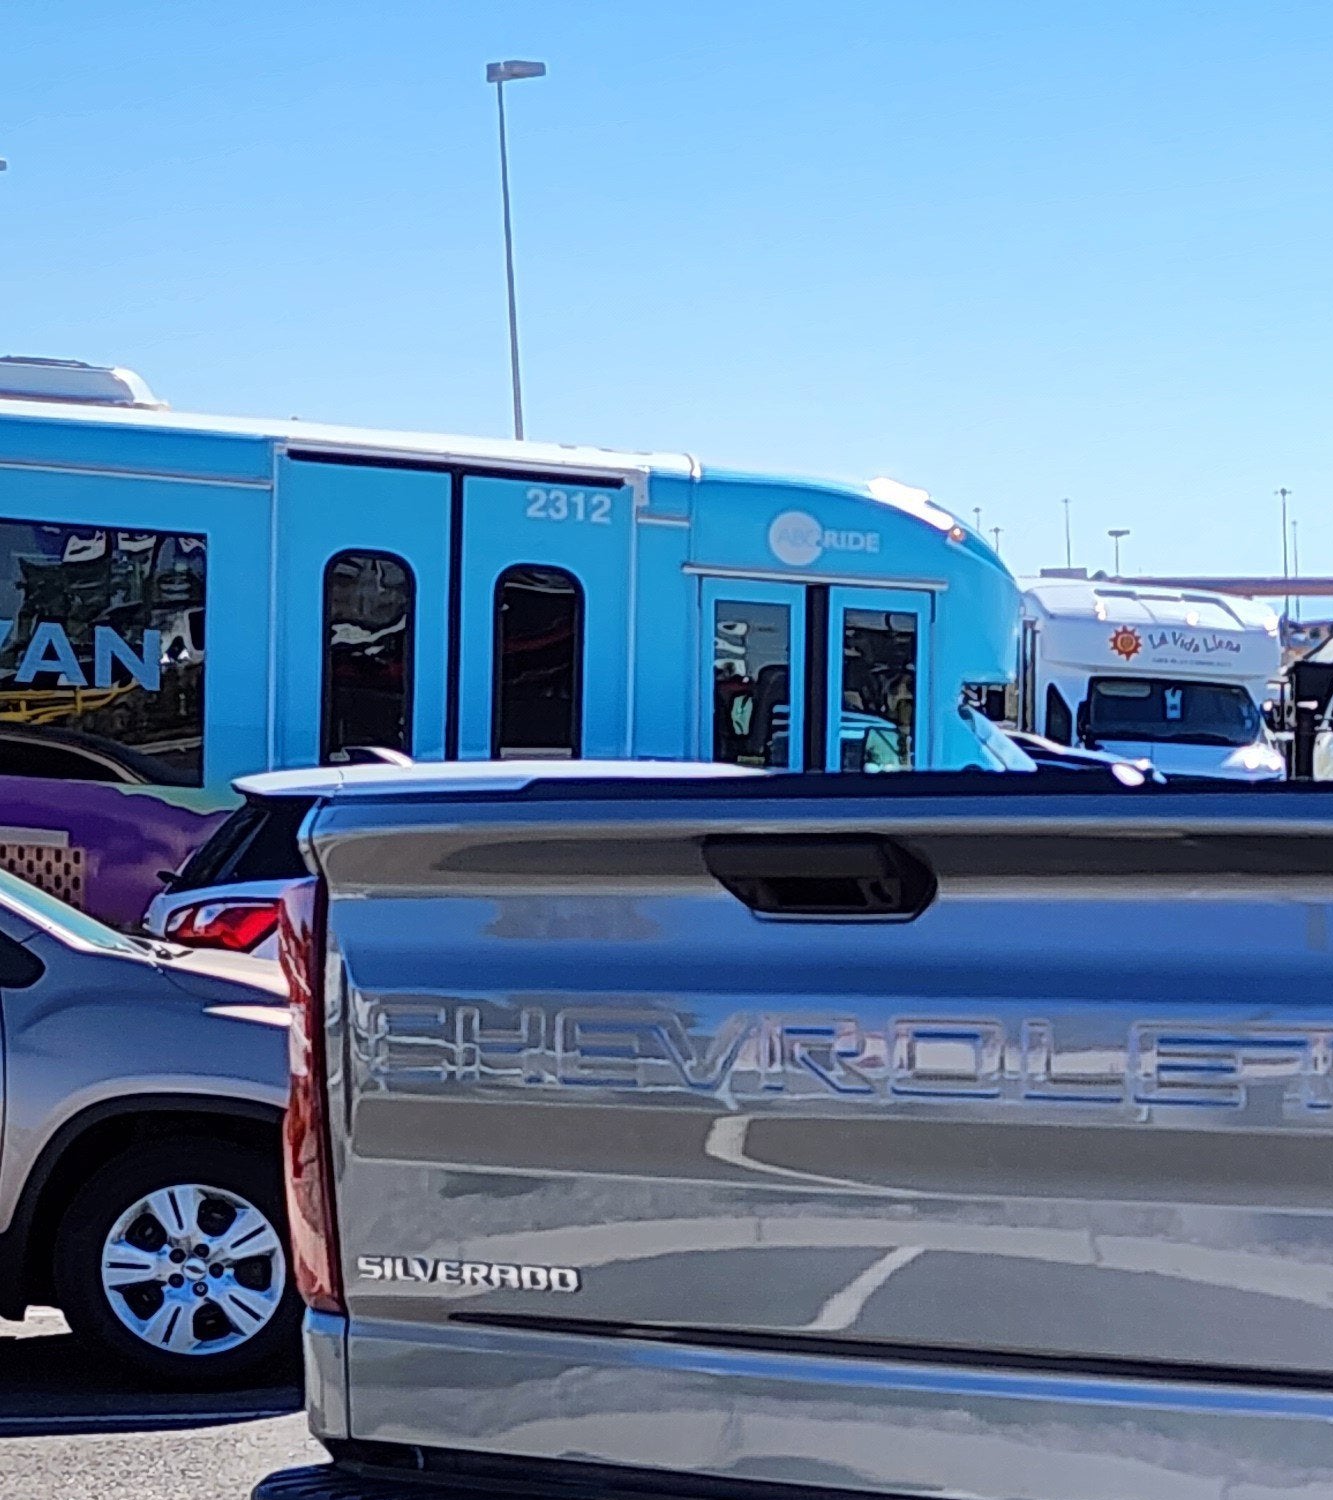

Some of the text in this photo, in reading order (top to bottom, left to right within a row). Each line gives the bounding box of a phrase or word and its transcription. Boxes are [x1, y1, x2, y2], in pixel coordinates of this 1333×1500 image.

[526, 488, 612, 524] 2312
[824, 531, 880, 553] RIDE
[357, 1255, 580, 1293] SILVERADO
